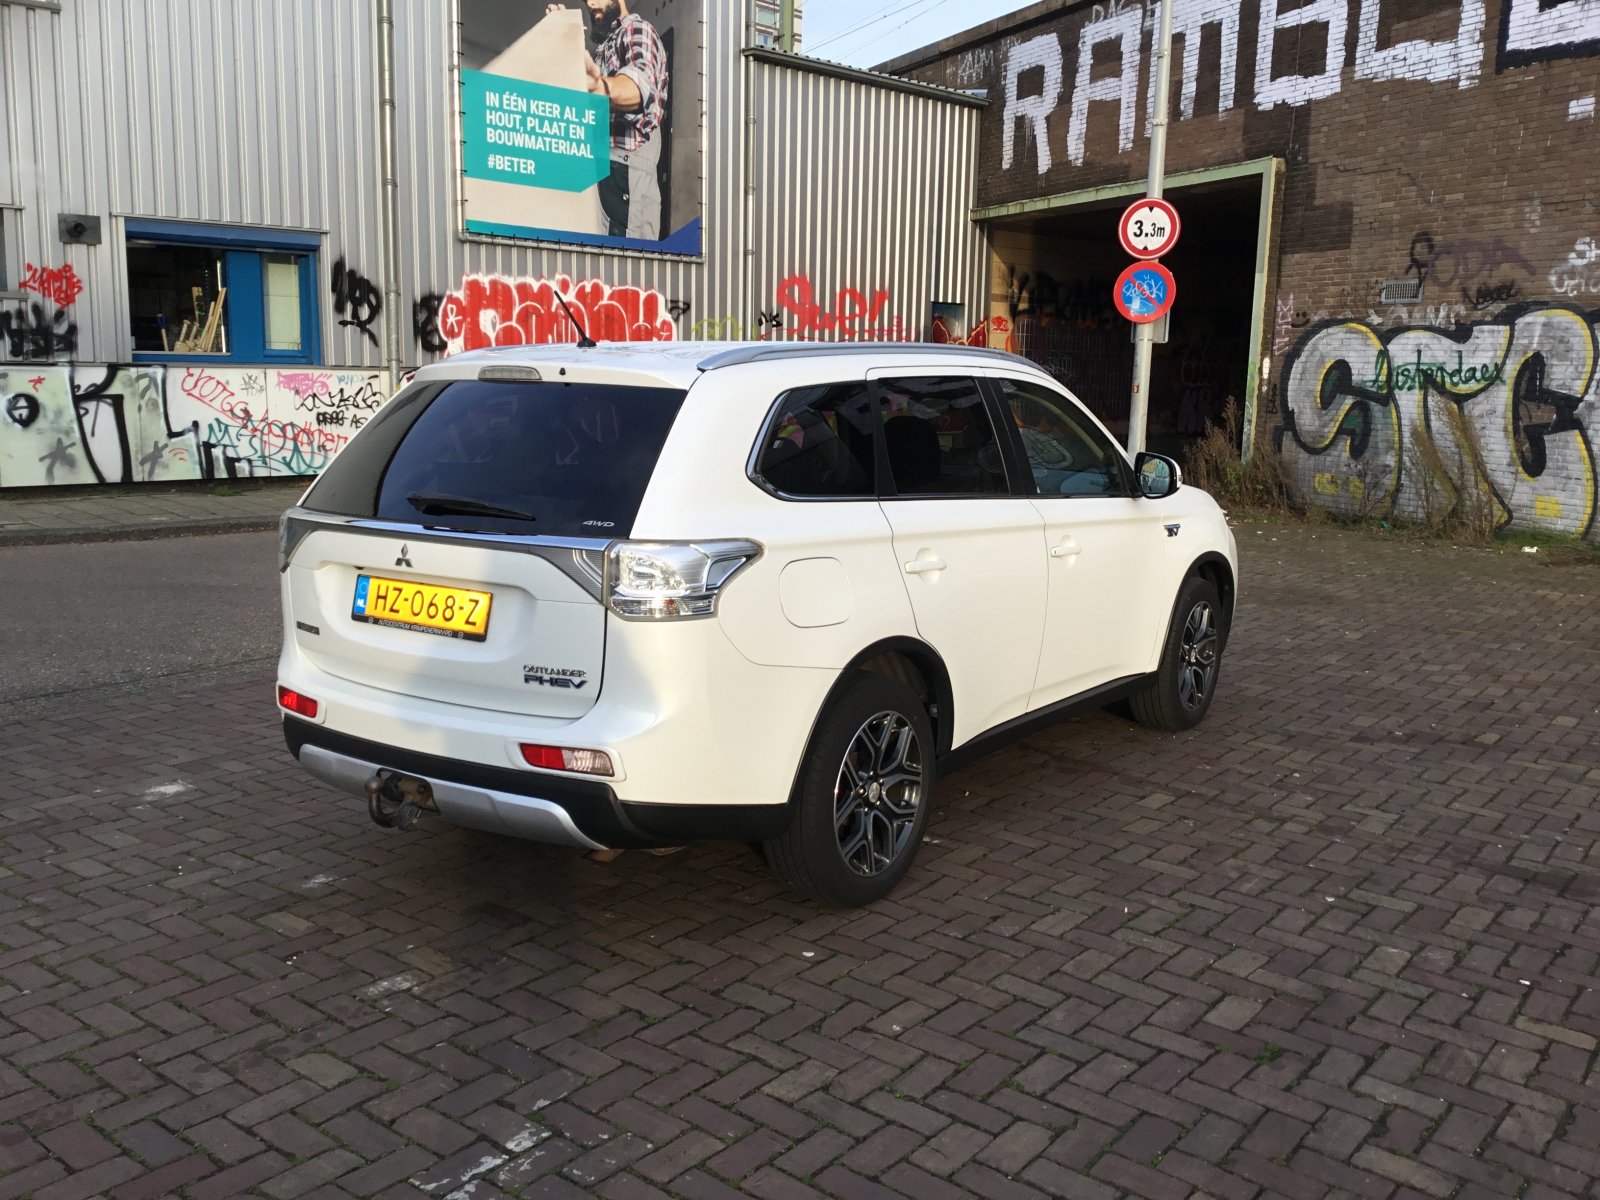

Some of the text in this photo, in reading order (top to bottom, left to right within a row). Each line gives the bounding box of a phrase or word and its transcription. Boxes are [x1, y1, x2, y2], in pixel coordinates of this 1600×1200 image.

[486, 91, 596, 125] IN ÉÉN KEER AL JE
[486, 109, 585, 140] HOUT, PLAAT EN
[486, 127, 594, 159] BOUWMATERIAAL
[487, 153, 536, 175] #BETER
[1133, 219, 1166, 238] 3.3m
[356, 598, 366, 608] NL
[374, 583, 480, 627] HZ-068-Z
[523, 664, 587, 678] OUTLANDER
[523, 673, 589, 690] PHEV
